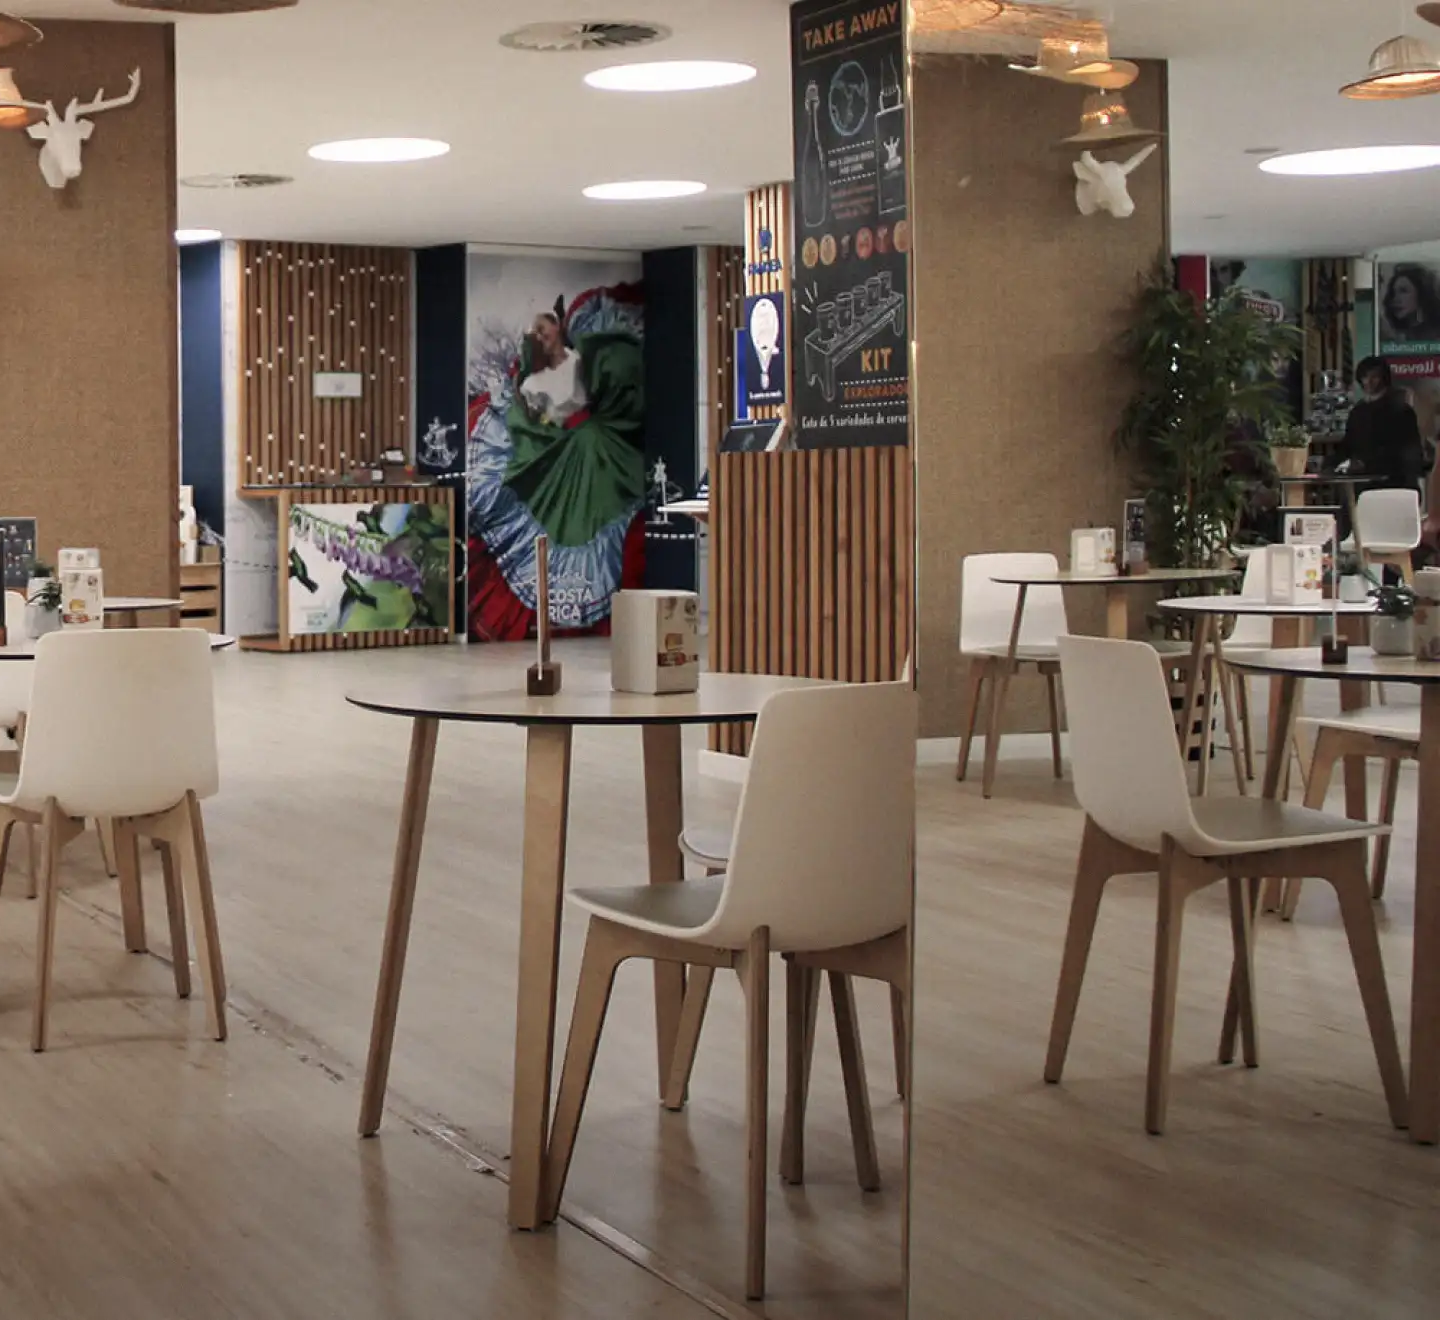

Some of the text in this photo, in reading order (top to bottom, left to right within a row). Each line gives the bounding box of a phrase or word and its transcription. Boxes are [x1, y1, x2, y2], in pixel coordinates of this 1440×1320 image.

[803, 1, 898, 51] TAKE AWAY
[861, 347, 892, 373] KIT
